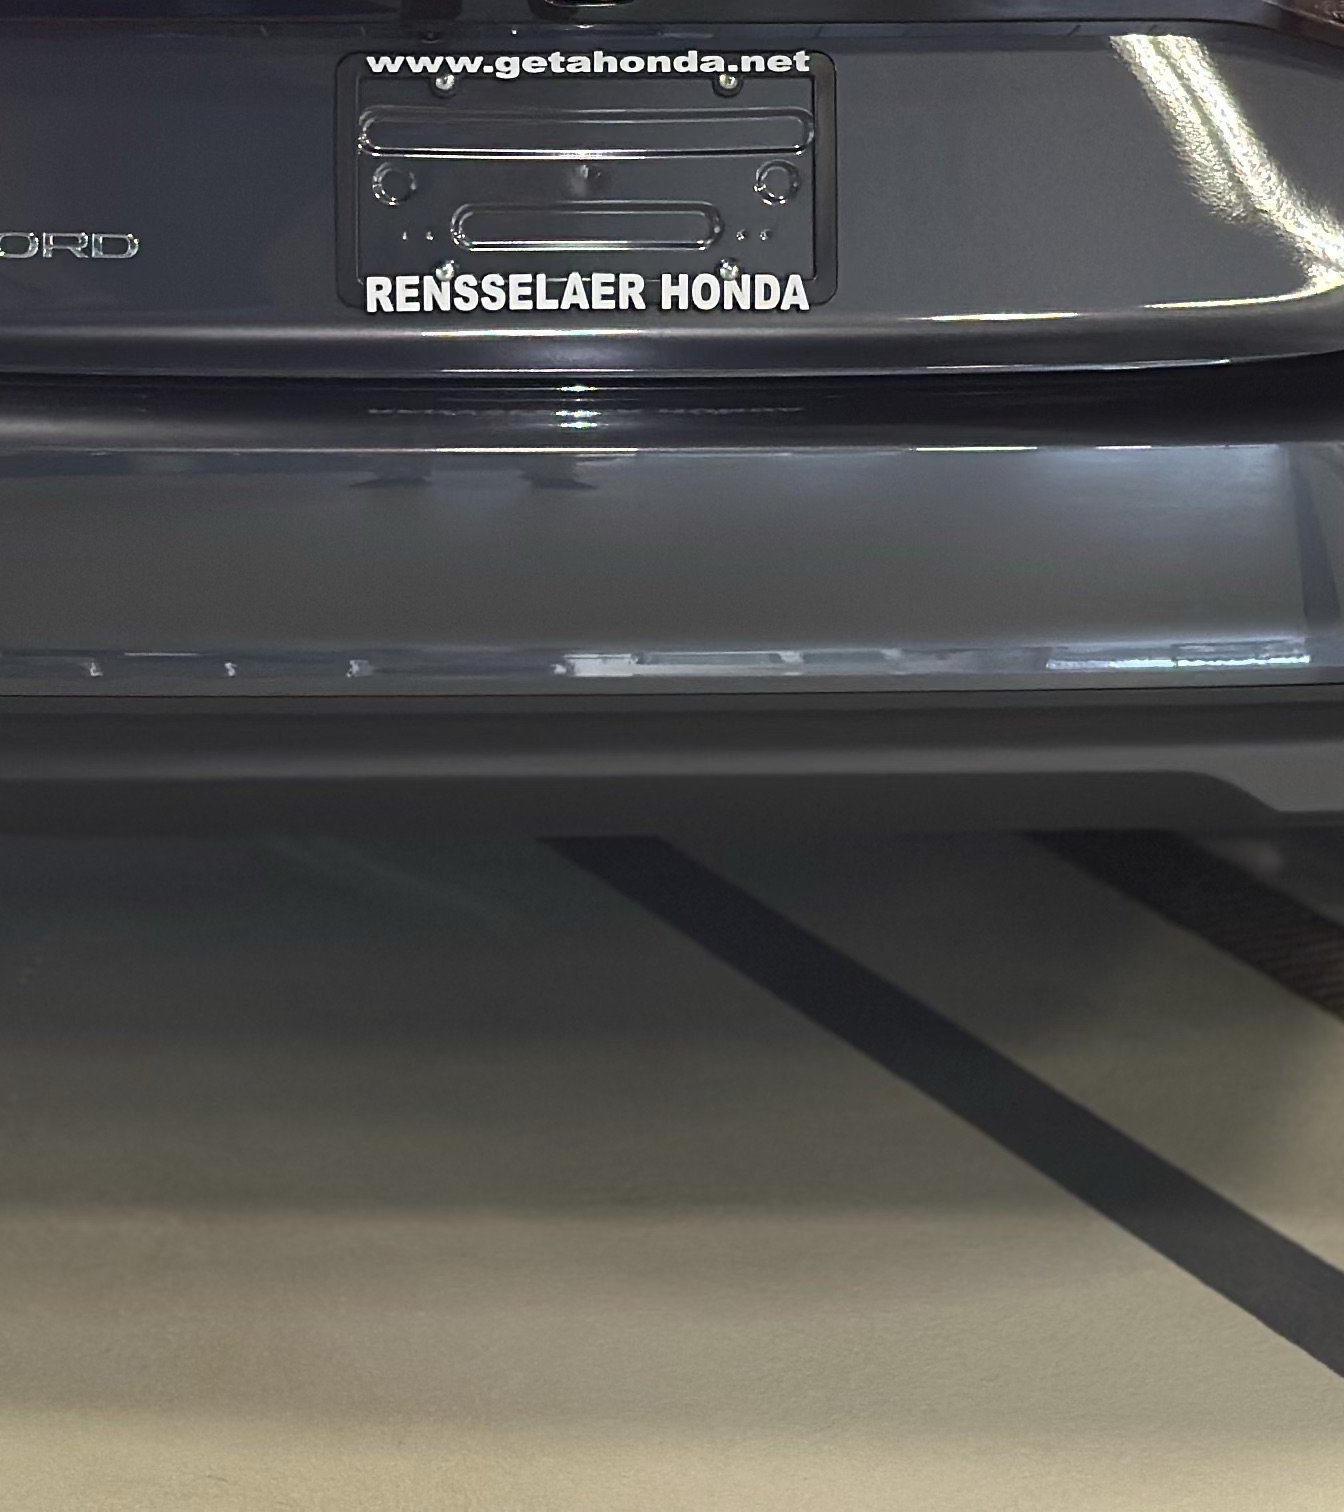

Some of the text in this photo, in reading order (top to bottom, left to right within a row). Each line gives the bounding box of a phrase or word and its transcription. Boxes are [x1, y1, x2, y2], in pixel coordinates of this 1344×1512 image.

[366, 50, 810, 79] www.getahonda.net
[366, 274, 810, 312] RENSSELAER HONDA
